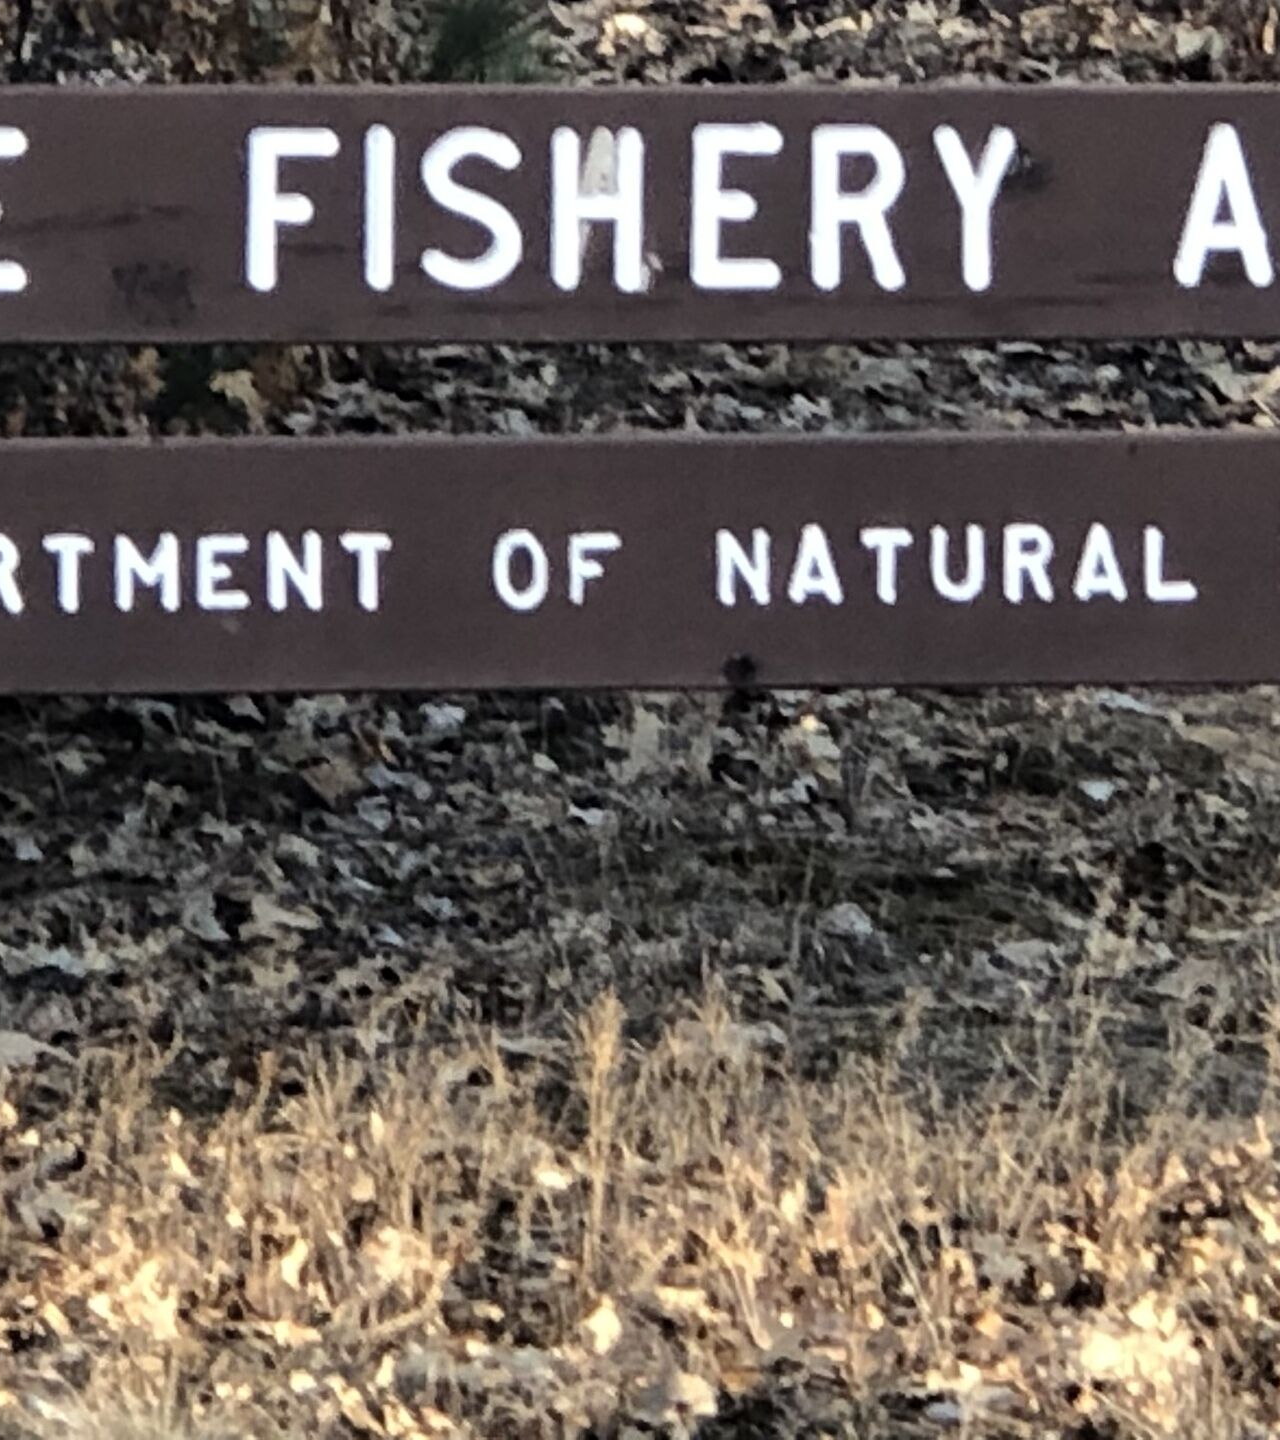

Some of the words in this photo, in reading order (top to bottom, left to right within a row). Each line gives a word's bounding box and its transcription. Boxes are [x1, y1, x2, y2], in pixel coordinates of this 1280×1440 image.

[246, 122, 1017, 294] FISHERY
[493, 528, 621, 609] OF
[716, 523, 1198, 605] NATURAL
